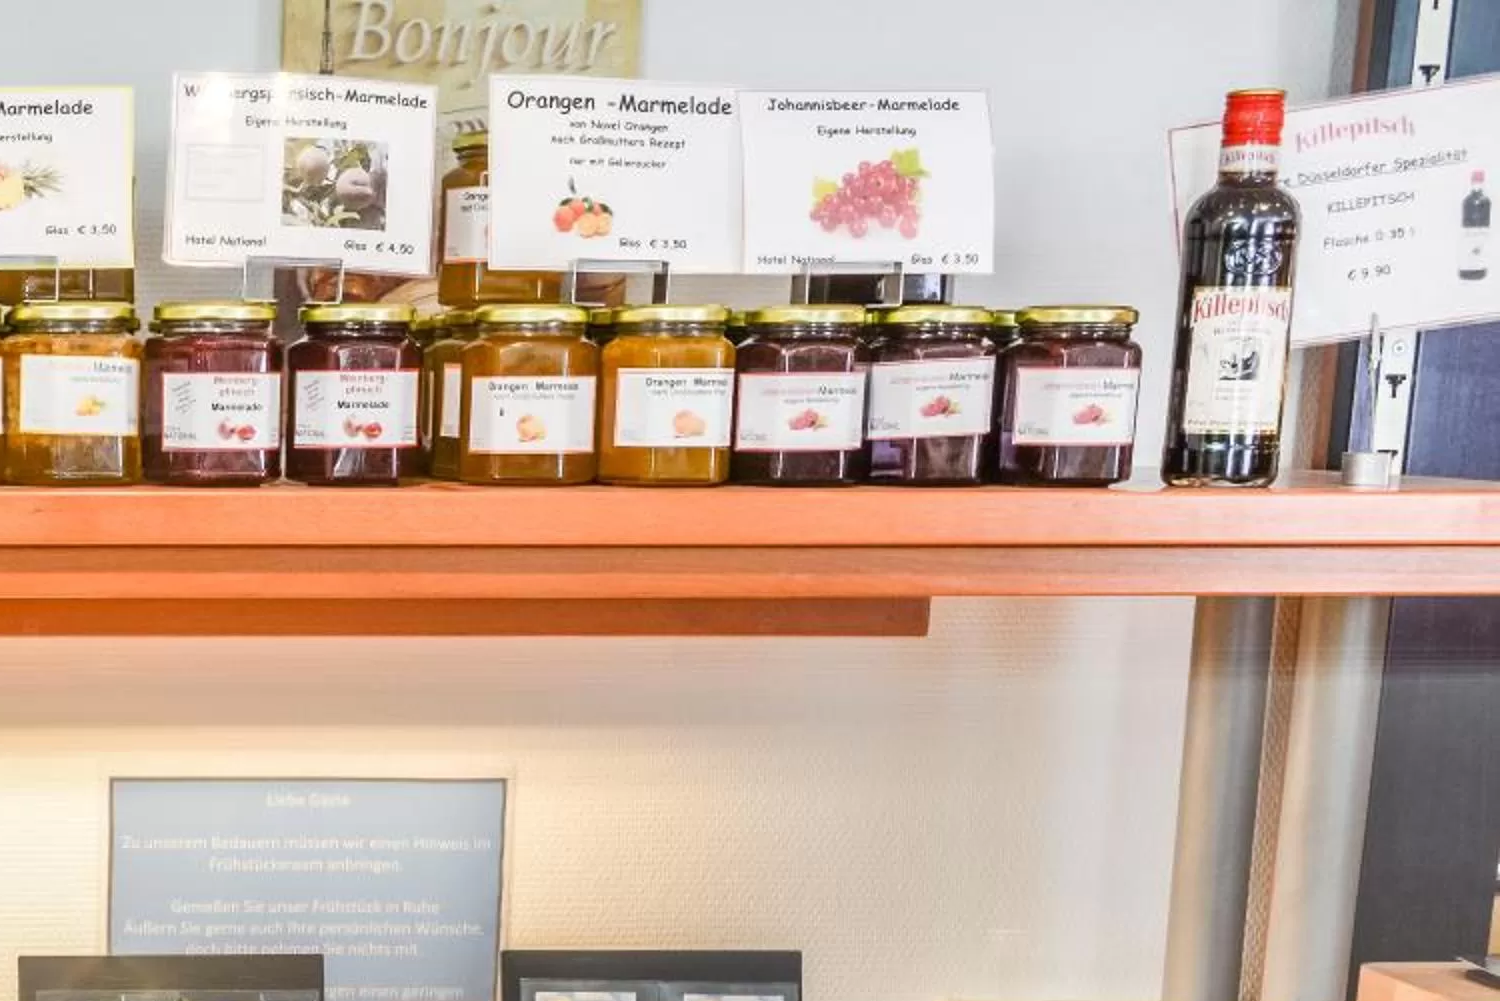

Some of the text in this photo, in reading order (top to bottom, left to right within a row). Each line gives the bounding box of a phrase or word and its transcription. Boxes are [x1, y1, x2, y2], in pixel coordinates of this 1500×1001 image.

[346, 0, 616, 78] Bonjour
[184, 84, 428, 110] Wergsrsisch-Marmelade
[507, 91, 595, 112] Orangen
[767, 98, 960, 112] Johannisbeer-Marmelade
[625, 121, 668, 134] Orangen
[817, 125, 917, 138] Eigene Herstellung
[1295, 115, 1415, 153] Killepitsch
[650, 138, 686, 150] Rezept
[1298, 149, 1468, 187] Düsseldorfer Spezialität
[1327, 191, 1415, 214] KILLEPITSCH
[45, 225, 69, 236] Glas
[77, 225, 86, 235] €
[185, 235, 216, 246] Hotel
[219, 236, 267, 247] National
[375, 241, 384, 252] €
[649, 238, 658, 249] €
[757, 254, 787, 265] Hotel
[941, 254, 949, 265] €
